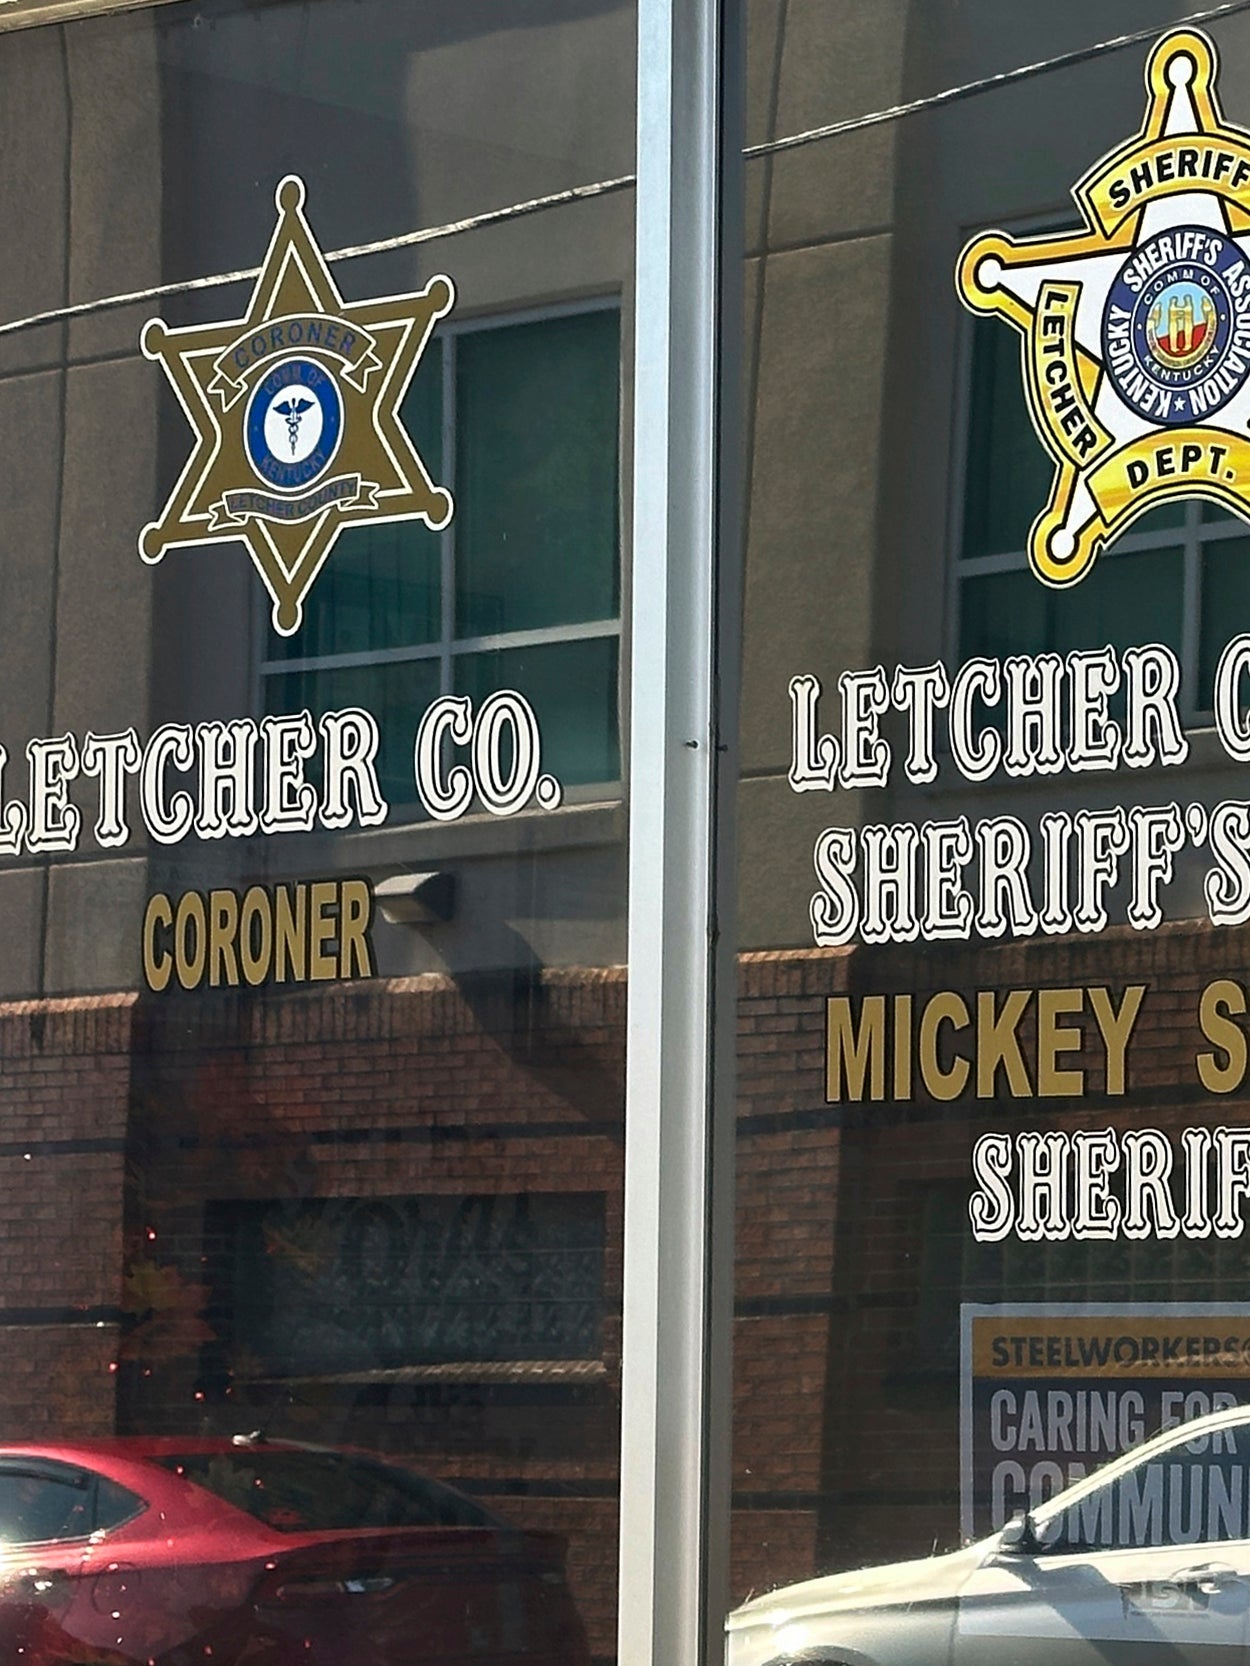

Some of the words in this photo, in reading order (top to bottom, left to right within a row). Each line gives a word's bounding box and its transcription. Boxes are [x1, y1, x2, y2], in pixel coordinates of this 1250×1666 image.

[1123, 232, 1223, 292] SHERIFF'S
[1201, 270, 1221, 295] OF
[233, 322, 357, 369] CORONER
[1044, 291, 1098, 458] LETCHER
[1107, 305, 1172, 418] KENTUCKY
[1143, 345, 1220, 381] KENTUCKY
[230, 495, 294, 516] LETCHER
[298, 481, 355, 514] COUNTY
[262, 452, 325, 483] KENTUCKY
[1126, 445, 1233, 489] DEPT.
[788, 643, 1190, 793] LETCHER
[0, 707, 388, 856] LETCHER
[415, 689, 563, 822] CO.
[143, 879, 374, 992] CORONER
[826, 985, 1147, 1102] MICKEY
[991, 1389, 1145, 1452] CARING
[1162, 1391, 1237, 1455] FOR
